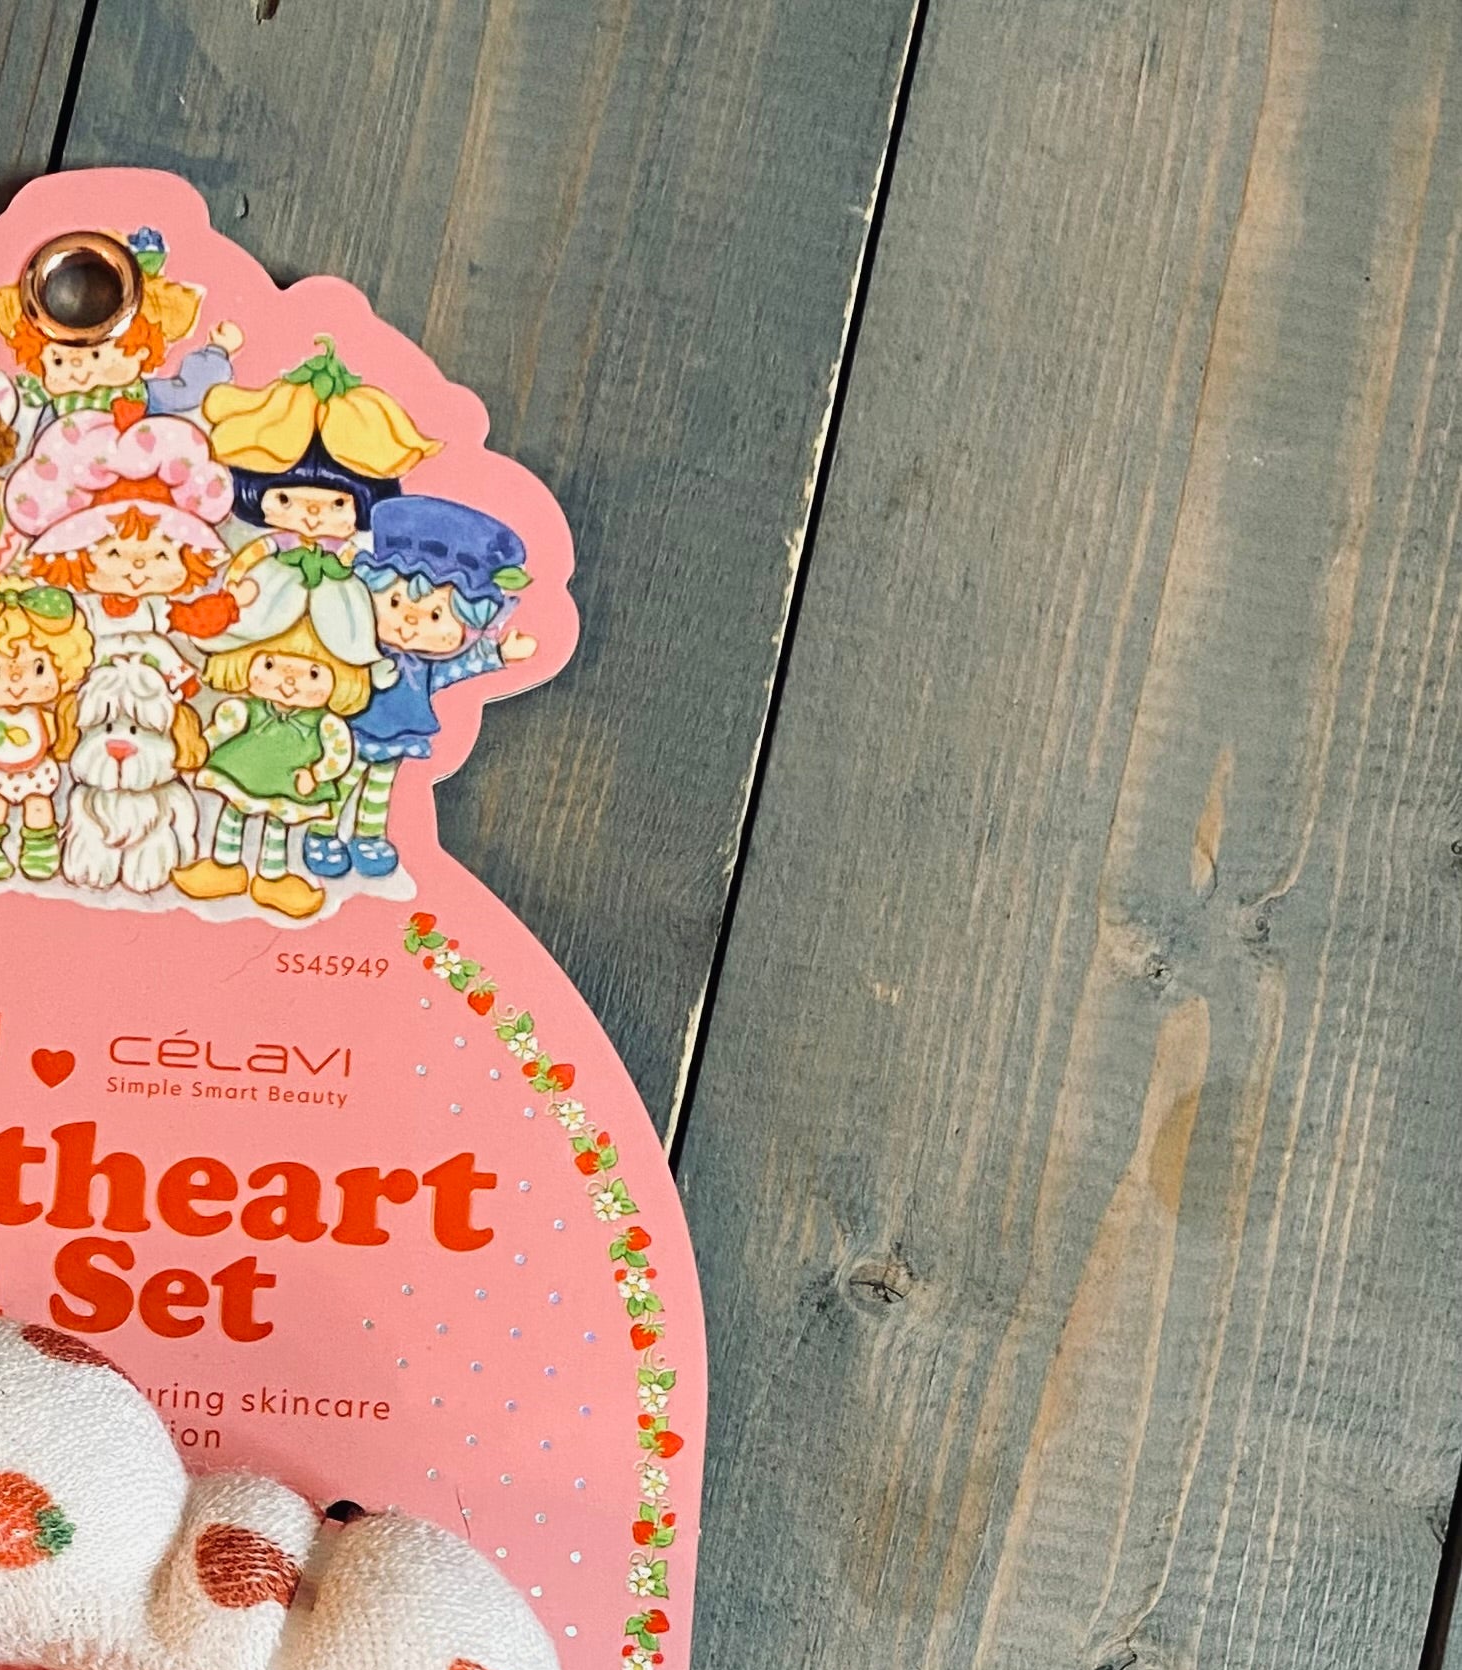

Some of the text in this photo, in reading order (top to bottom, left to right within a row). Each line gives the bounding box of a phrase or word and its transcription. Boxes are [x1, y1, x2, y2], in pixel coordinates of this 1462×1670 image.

[276, 953, 389, 978] SS45949
[106, 1076, 348, 1109] Simple Smart Beauty
[50, 1237, 276, 1343] Set
[241, 1386, 390, 1420] skincare
